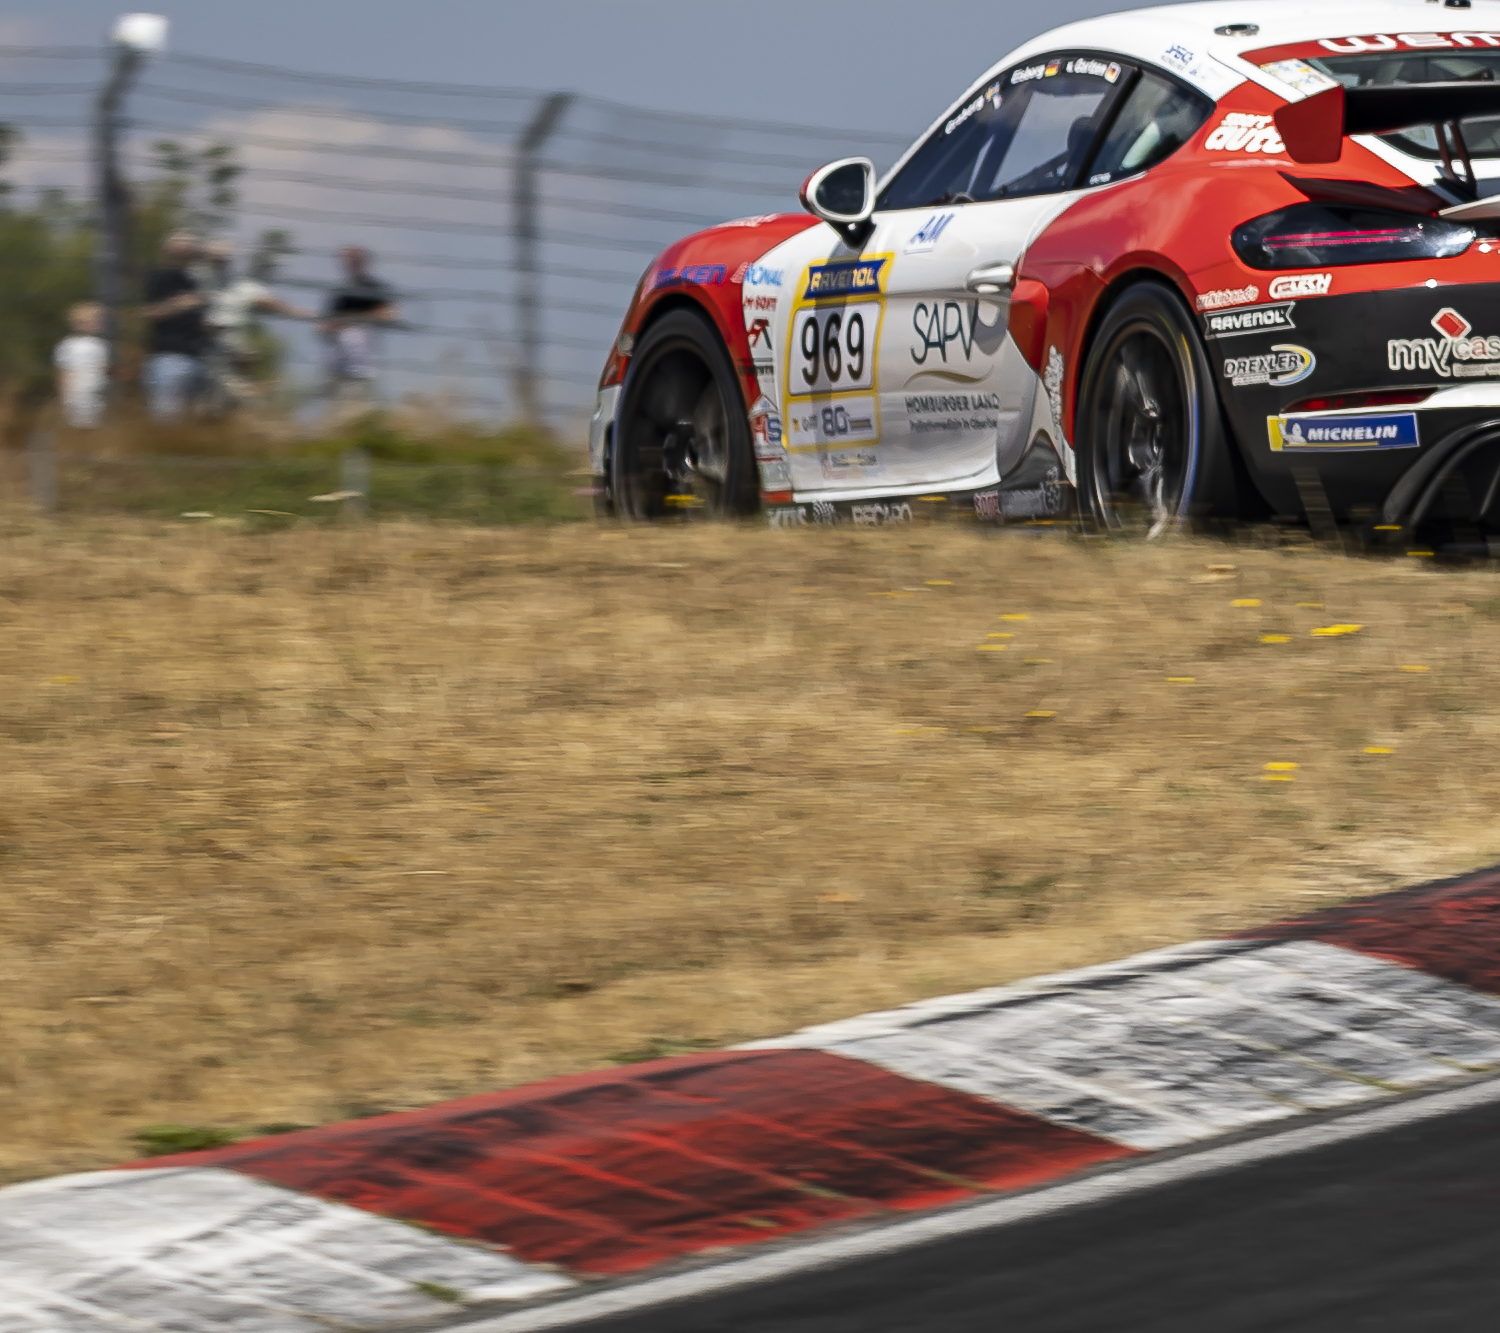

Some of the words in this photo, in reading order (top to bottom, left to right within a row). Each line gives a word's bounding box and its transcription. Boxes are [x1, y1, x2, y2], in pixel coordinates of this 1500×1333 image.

[911, 298, 979, 364] SAPV
[1211, 310, 1285, 331] RAVENOL
[801, 312, 865, 384] 969
[1224, 354, 1301, 378] DREXLER
[1307, 424, 1398, 441] MICHELIN
